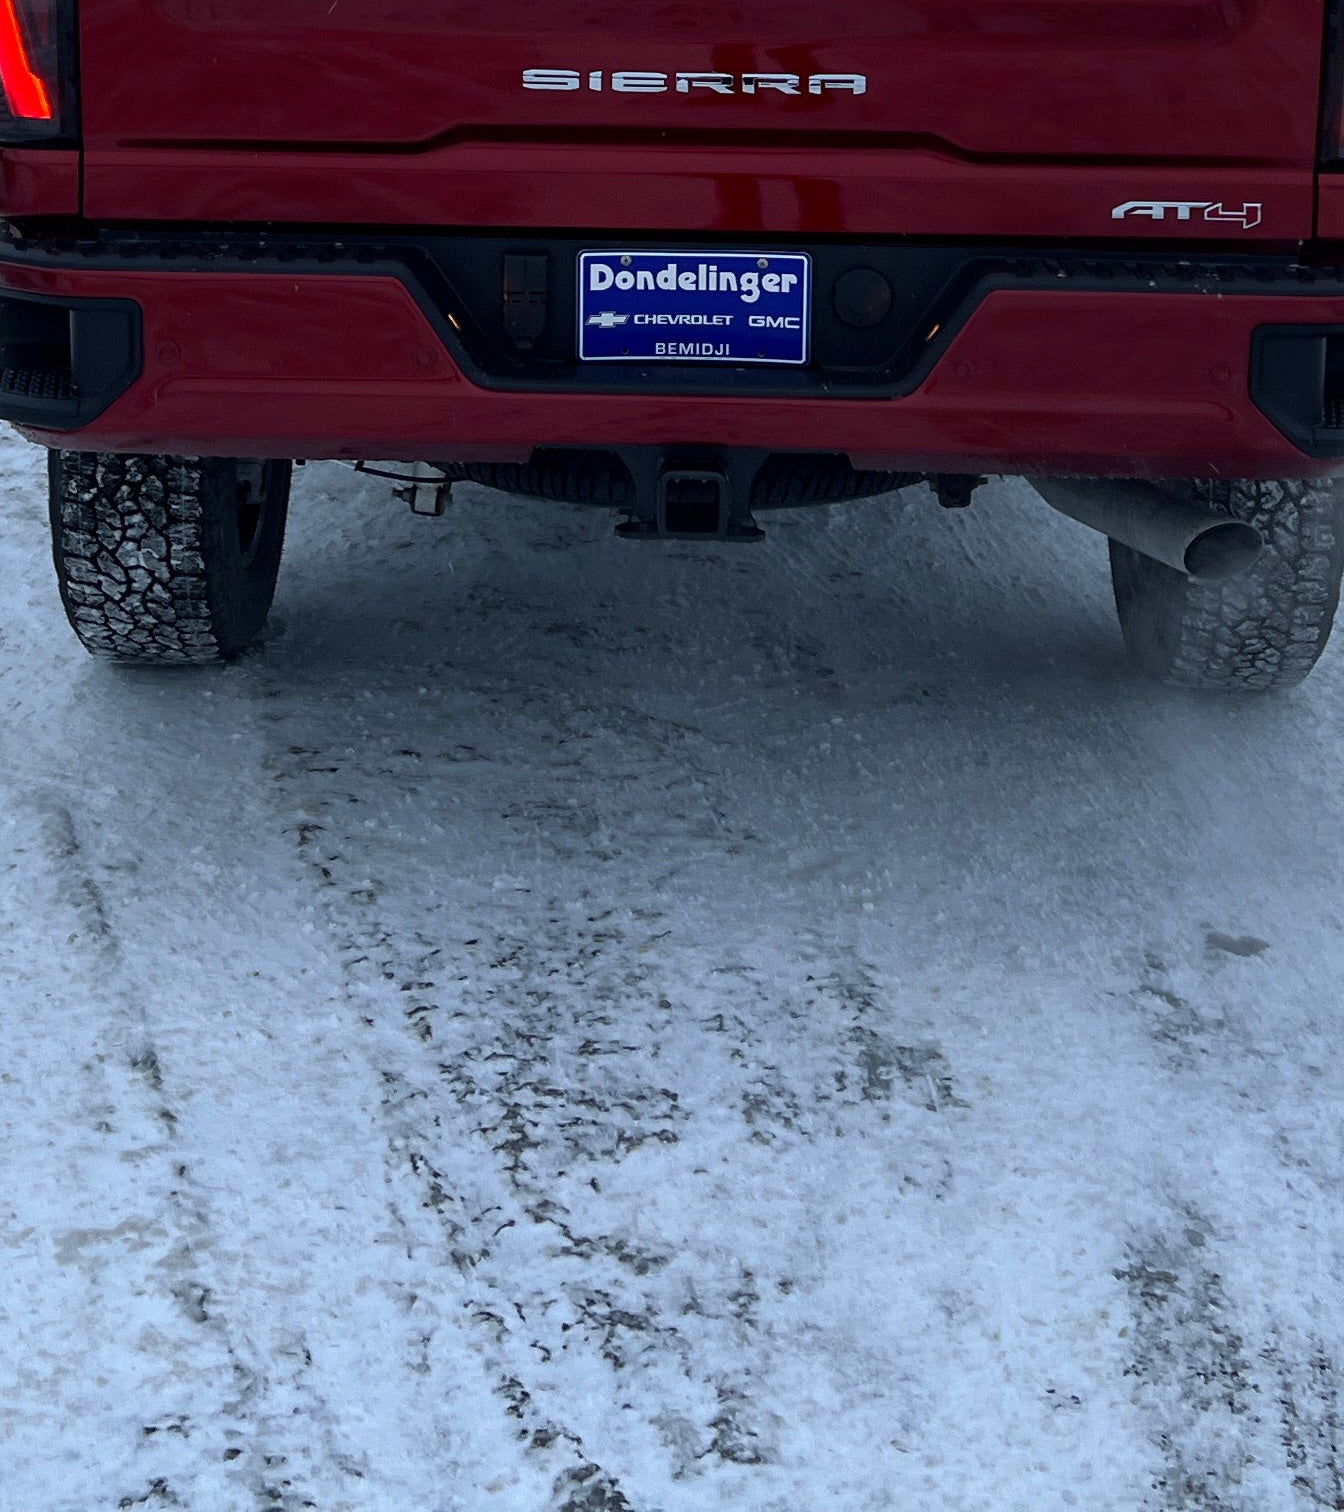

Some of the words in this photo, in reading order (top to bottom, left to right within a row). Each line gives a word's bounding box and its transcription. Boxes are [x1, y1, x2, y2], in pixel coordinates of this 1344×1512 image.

[522, 69, 867, 95] SIERRA
[1111, 201, 1262, 229] AT4
[589, 263, 798, 303] Dondelinger
[633, 314, 734, 326] CHEVROLET
[748, 315, 800, 329] GMC
[655, 343, 730, 356] BEMIDJI
